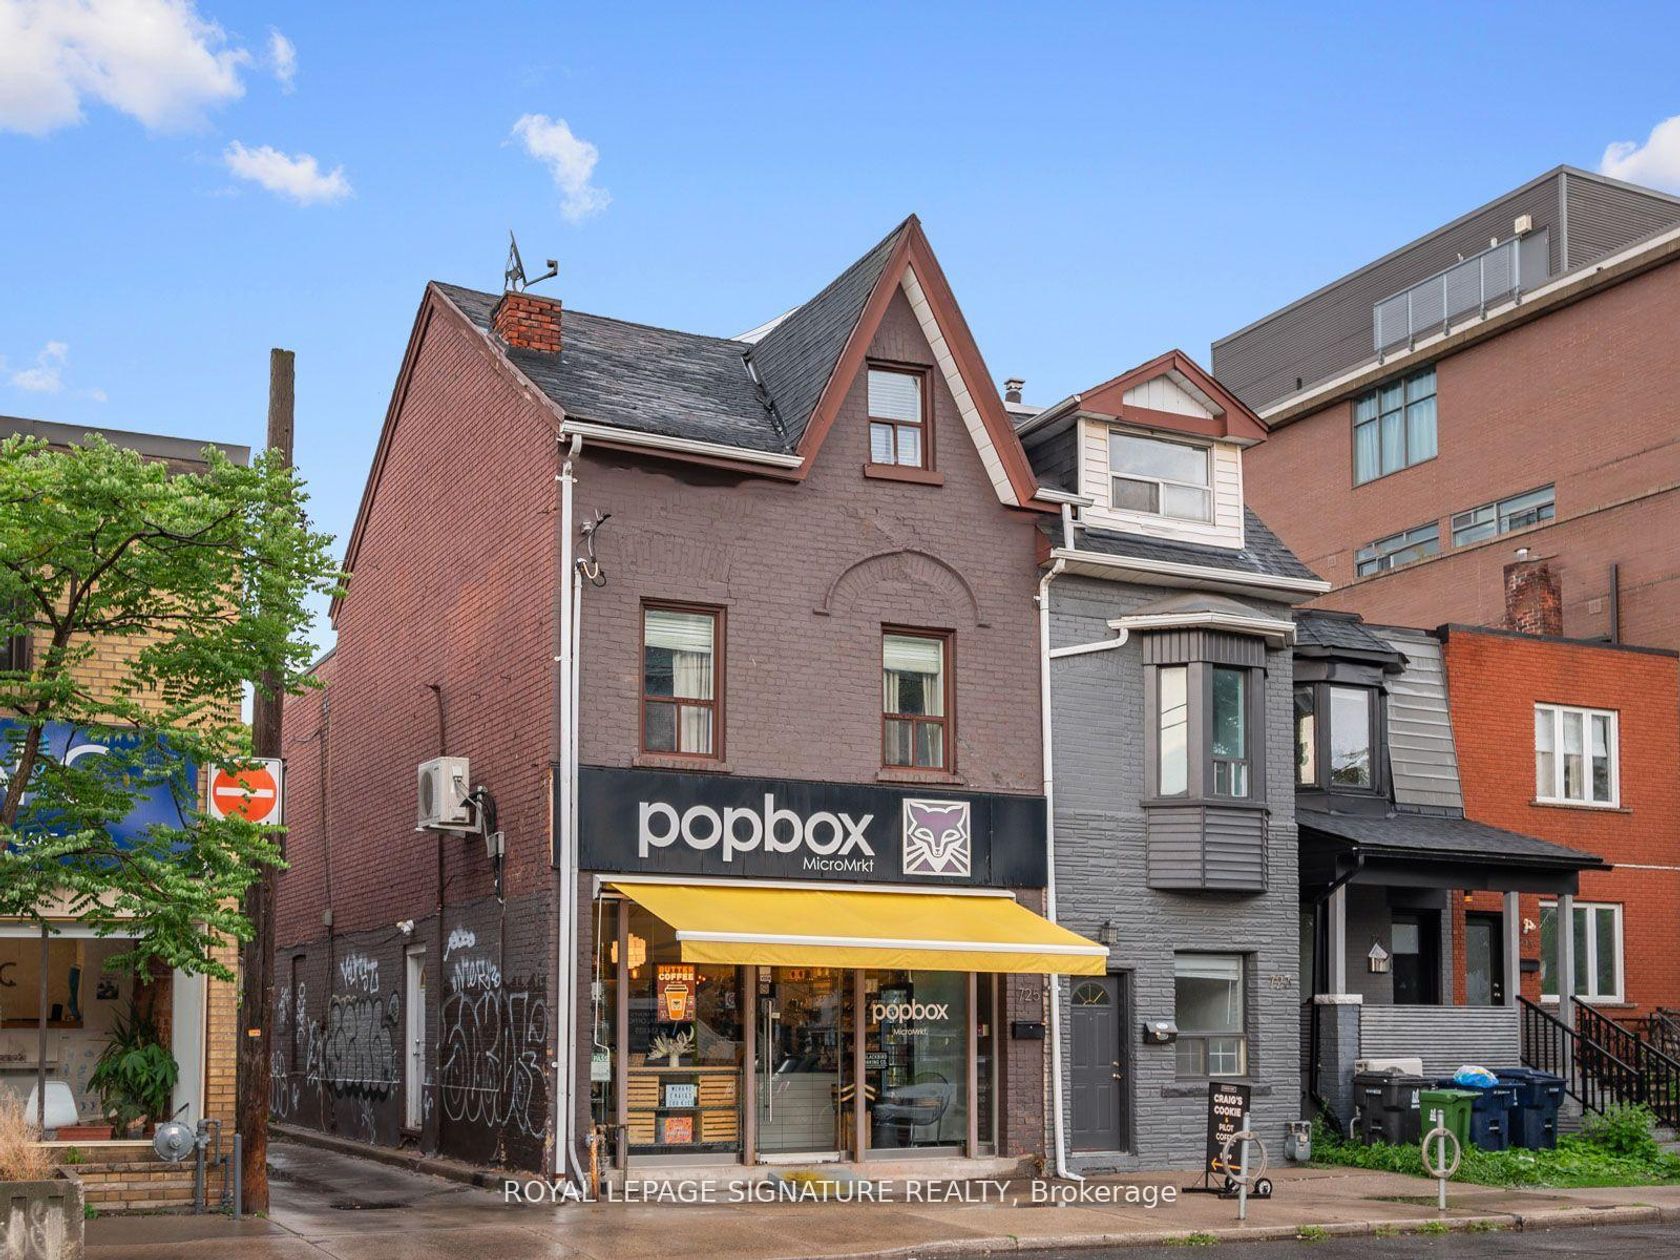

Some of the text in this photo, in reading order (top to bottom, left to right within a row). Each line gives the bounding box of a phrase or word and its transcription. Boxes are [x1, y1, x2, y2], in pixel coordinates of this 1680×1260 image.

[638, 793, 876, 862] popbox
[803, 856, 874, 873] MicroMrkt
[658, 973, 694, 981] COFFEE
[872, 998, 949, 1025] popbox
[1213, 1094, 1243, 1105] CRAIG'S
[1214, 1105, 1242, 1117] COOKIE
[1219, 1123, 1235, 1132] PILOT
